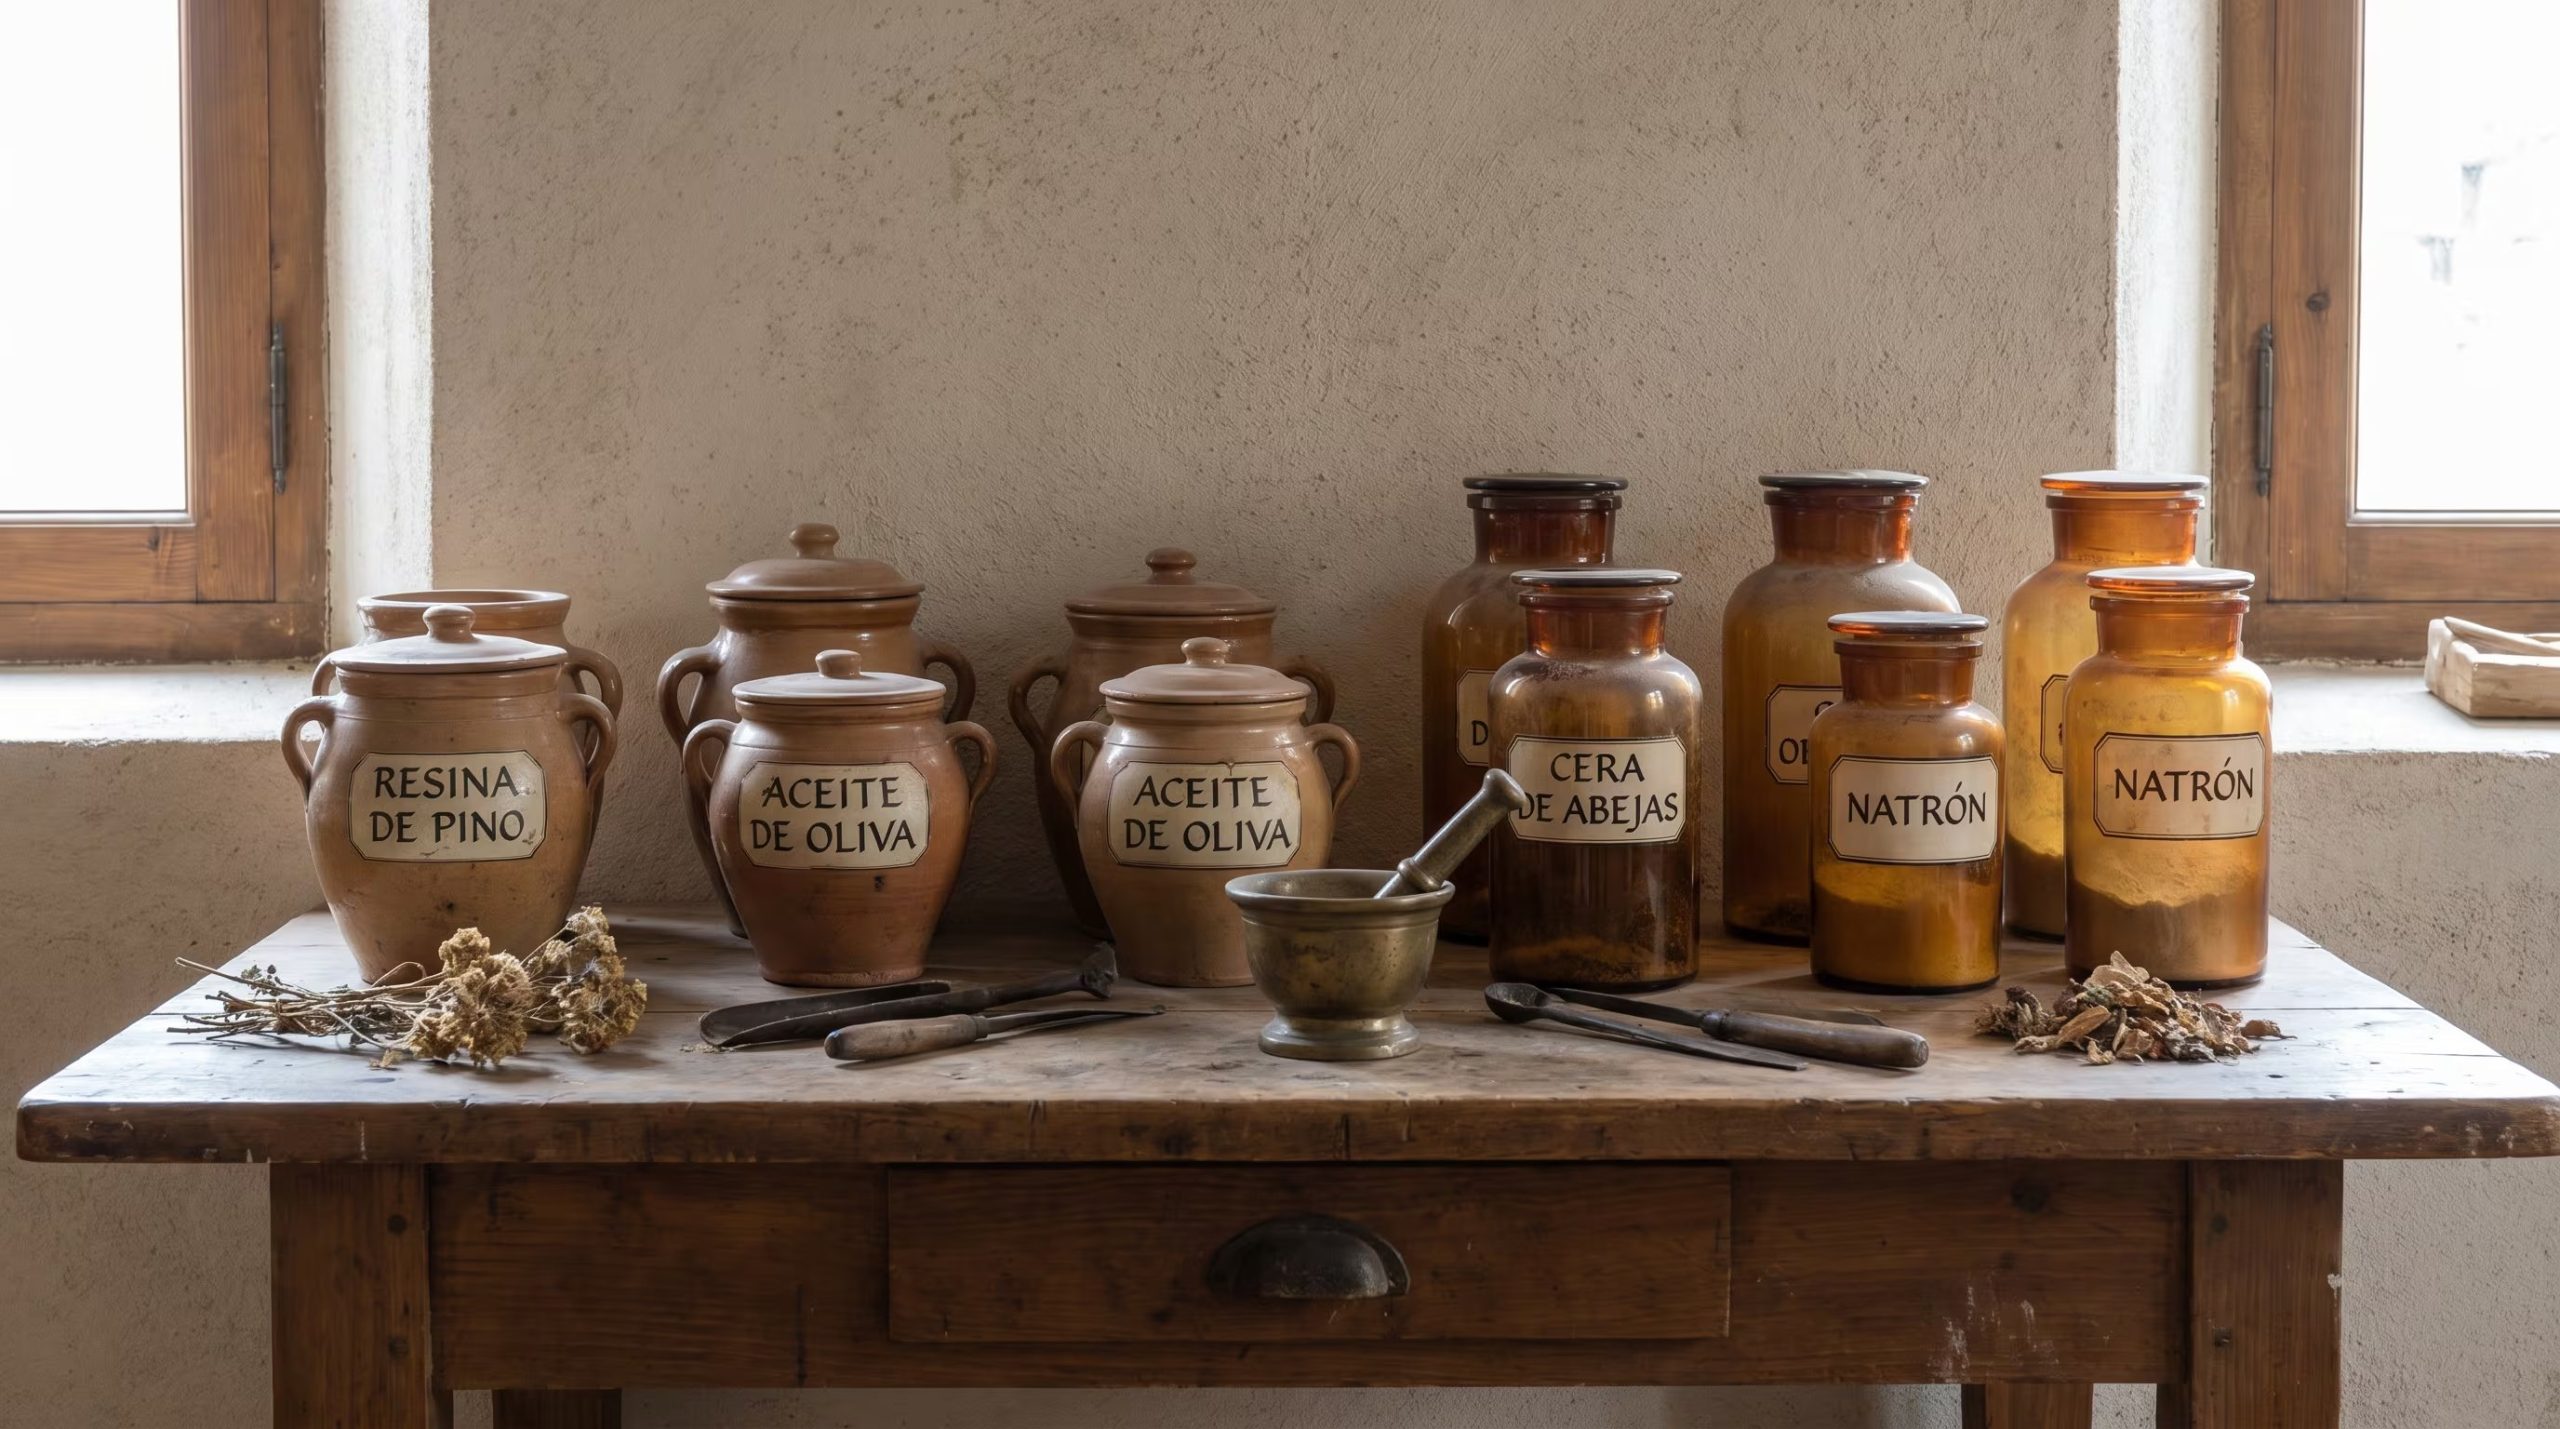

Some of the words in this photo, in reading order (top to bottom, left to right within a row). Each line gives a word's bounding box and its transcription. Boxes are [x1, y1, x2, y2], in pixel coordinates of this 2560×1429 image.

[373, 765, 519, 799] RESINA
[1550, 753, 1645, 783] CERA
[2114, 757, 2254, 802] NATRÓN
[761, 776, 903, 810] ACEITE
[1133, 776, 1272, 809] ACEITE
[1847, 781, 1987, 826] NATRÓN
[369, 811, 416, 842] DE
[431, 811, 524, 843] PINO
[1518, 792, 1554, 822] DE
[1562, 792, 1679, 833] ABEJAS
[749, 820, 793, 852] DE
[806, 820, 917, 853] OLIVA
[1124, 819, 1169, 851] DE
[1183, 819, 1292, 853] OLIVA
